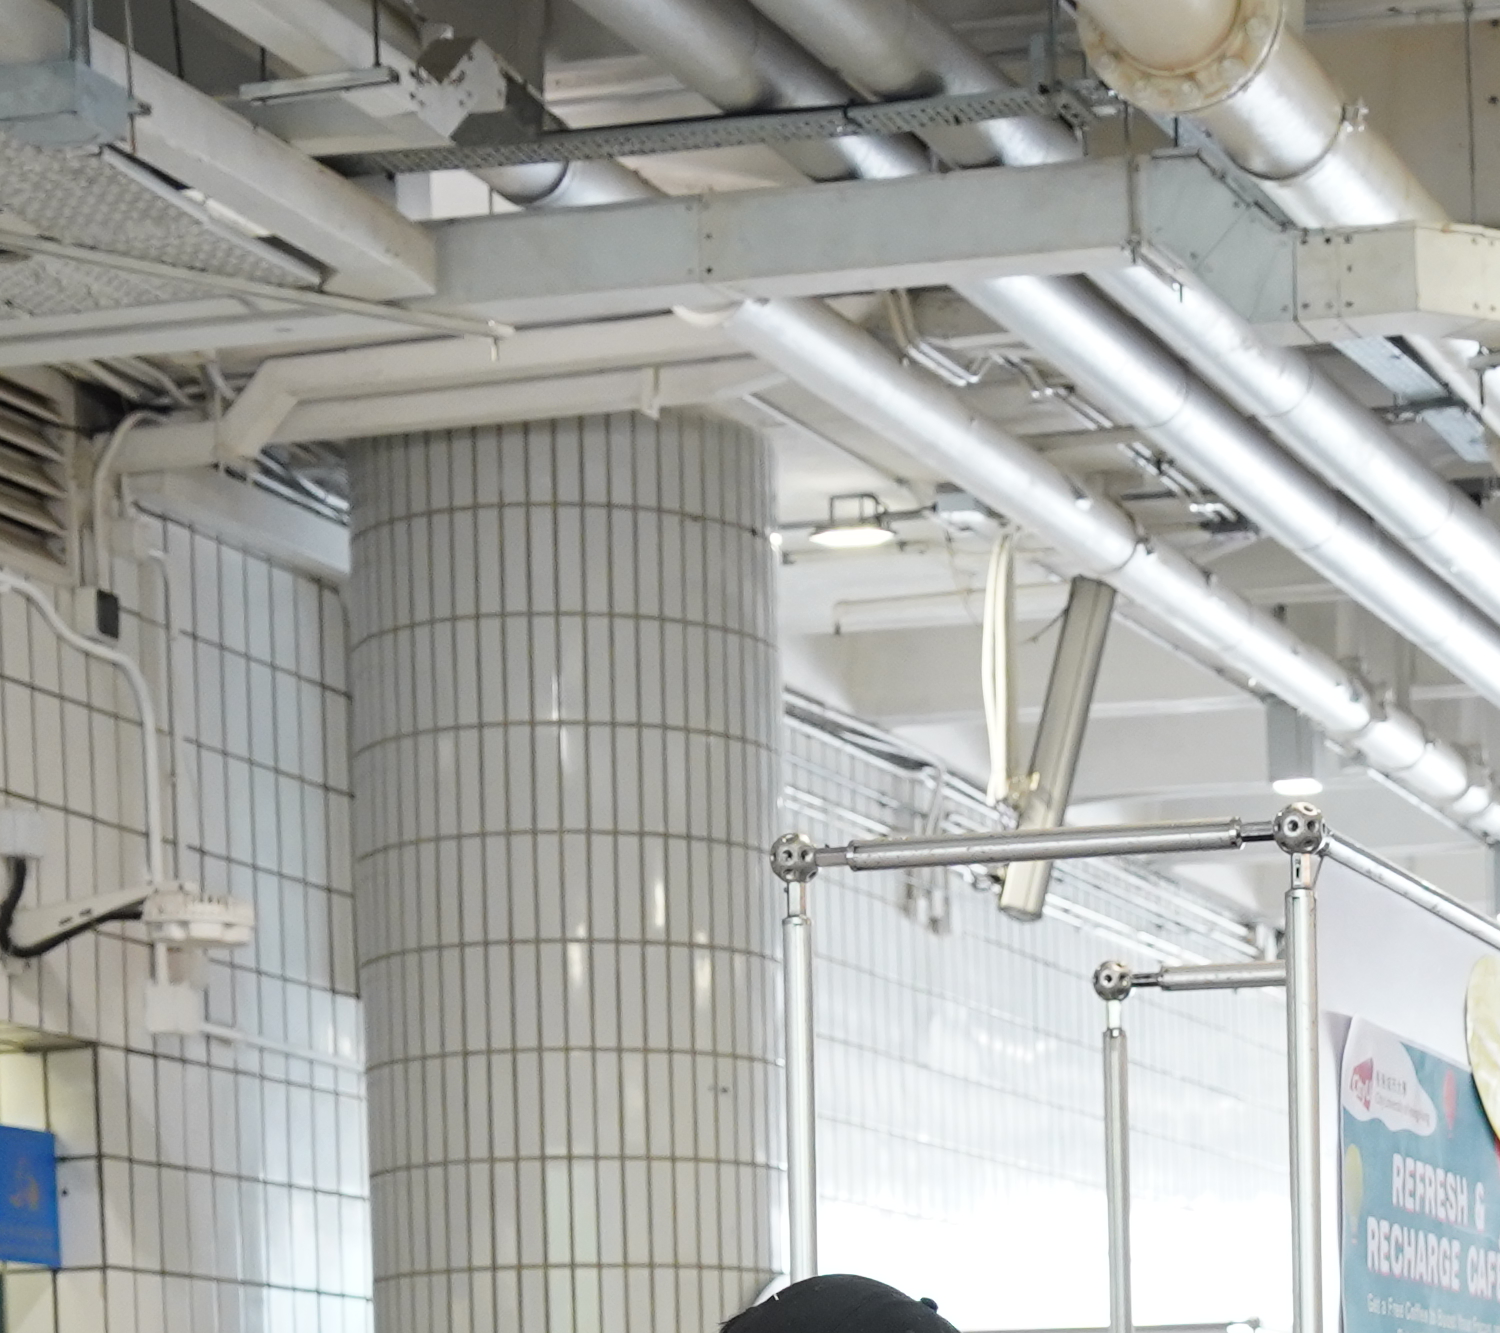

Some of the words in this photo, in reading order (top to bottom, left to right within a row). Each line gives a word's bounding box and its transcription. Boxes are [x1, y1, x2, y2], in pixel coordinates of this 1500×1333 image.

[1391, 1152, 1469, 1226] REFRESH
[1475, 1182, 1485, 1233] &
[1366, 1216, 1461, 1292] RECHARGE
